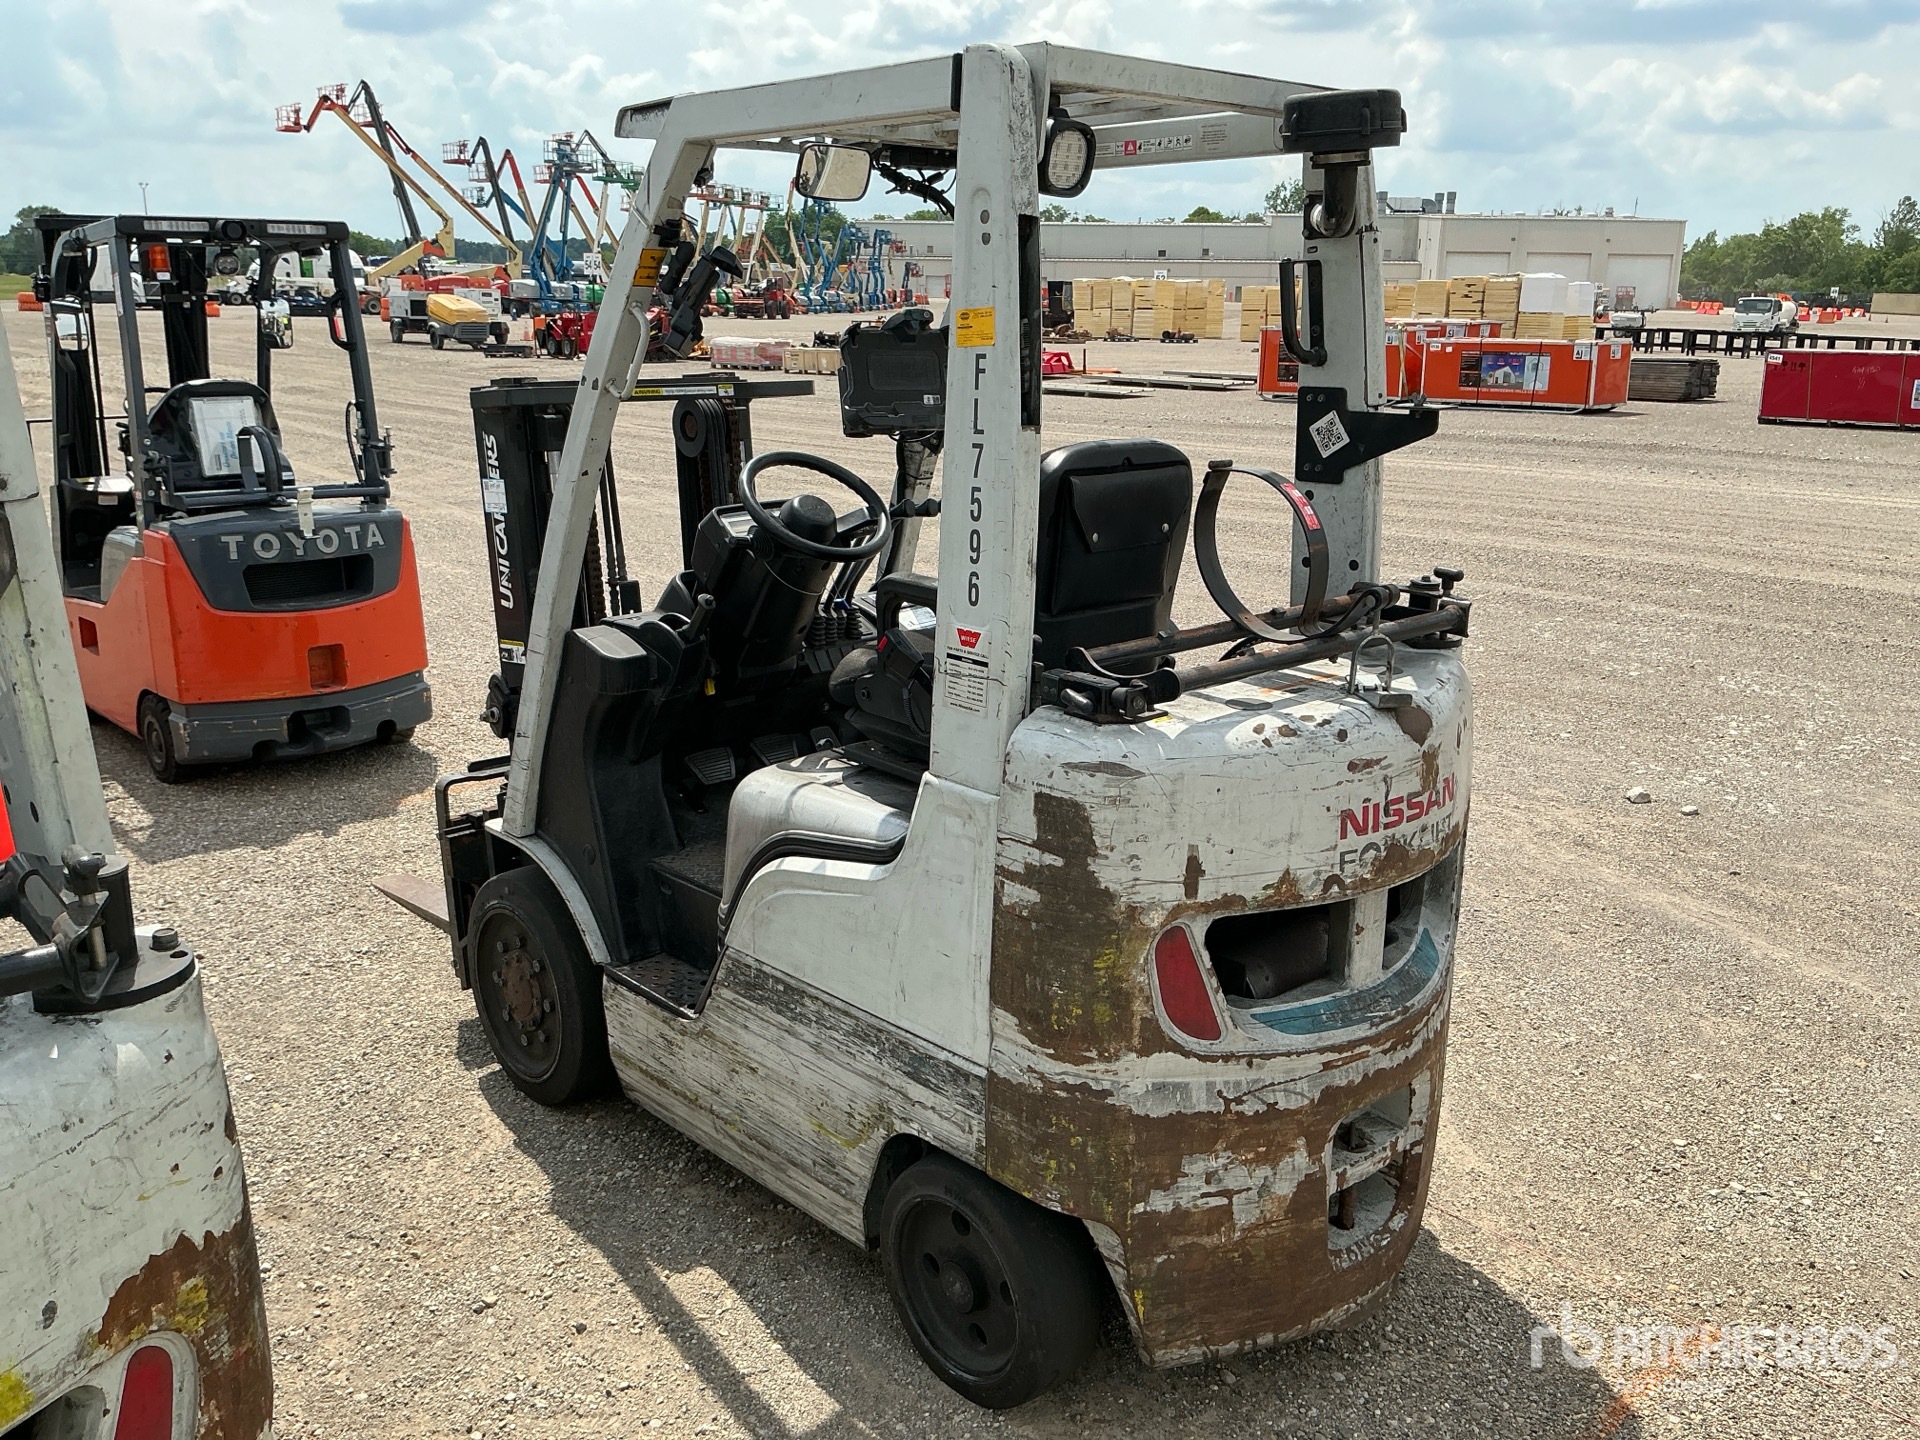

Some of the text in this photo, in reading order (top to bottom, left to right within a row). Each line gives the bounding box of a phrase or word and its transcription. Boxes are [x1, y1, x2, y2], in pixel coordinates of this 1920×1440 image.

[585, 260, 592, 270] 54
[594, 260, 601, 270] 54
[968, 353, 987, 607] FL7596
[220, 522, 386, 561] TOYOTA
[484, 432, 514, 610] UNICAERS
[1339, 771, 1456, 841] NISSAN
[1339, 814, 1452, 874] FOKIFT
